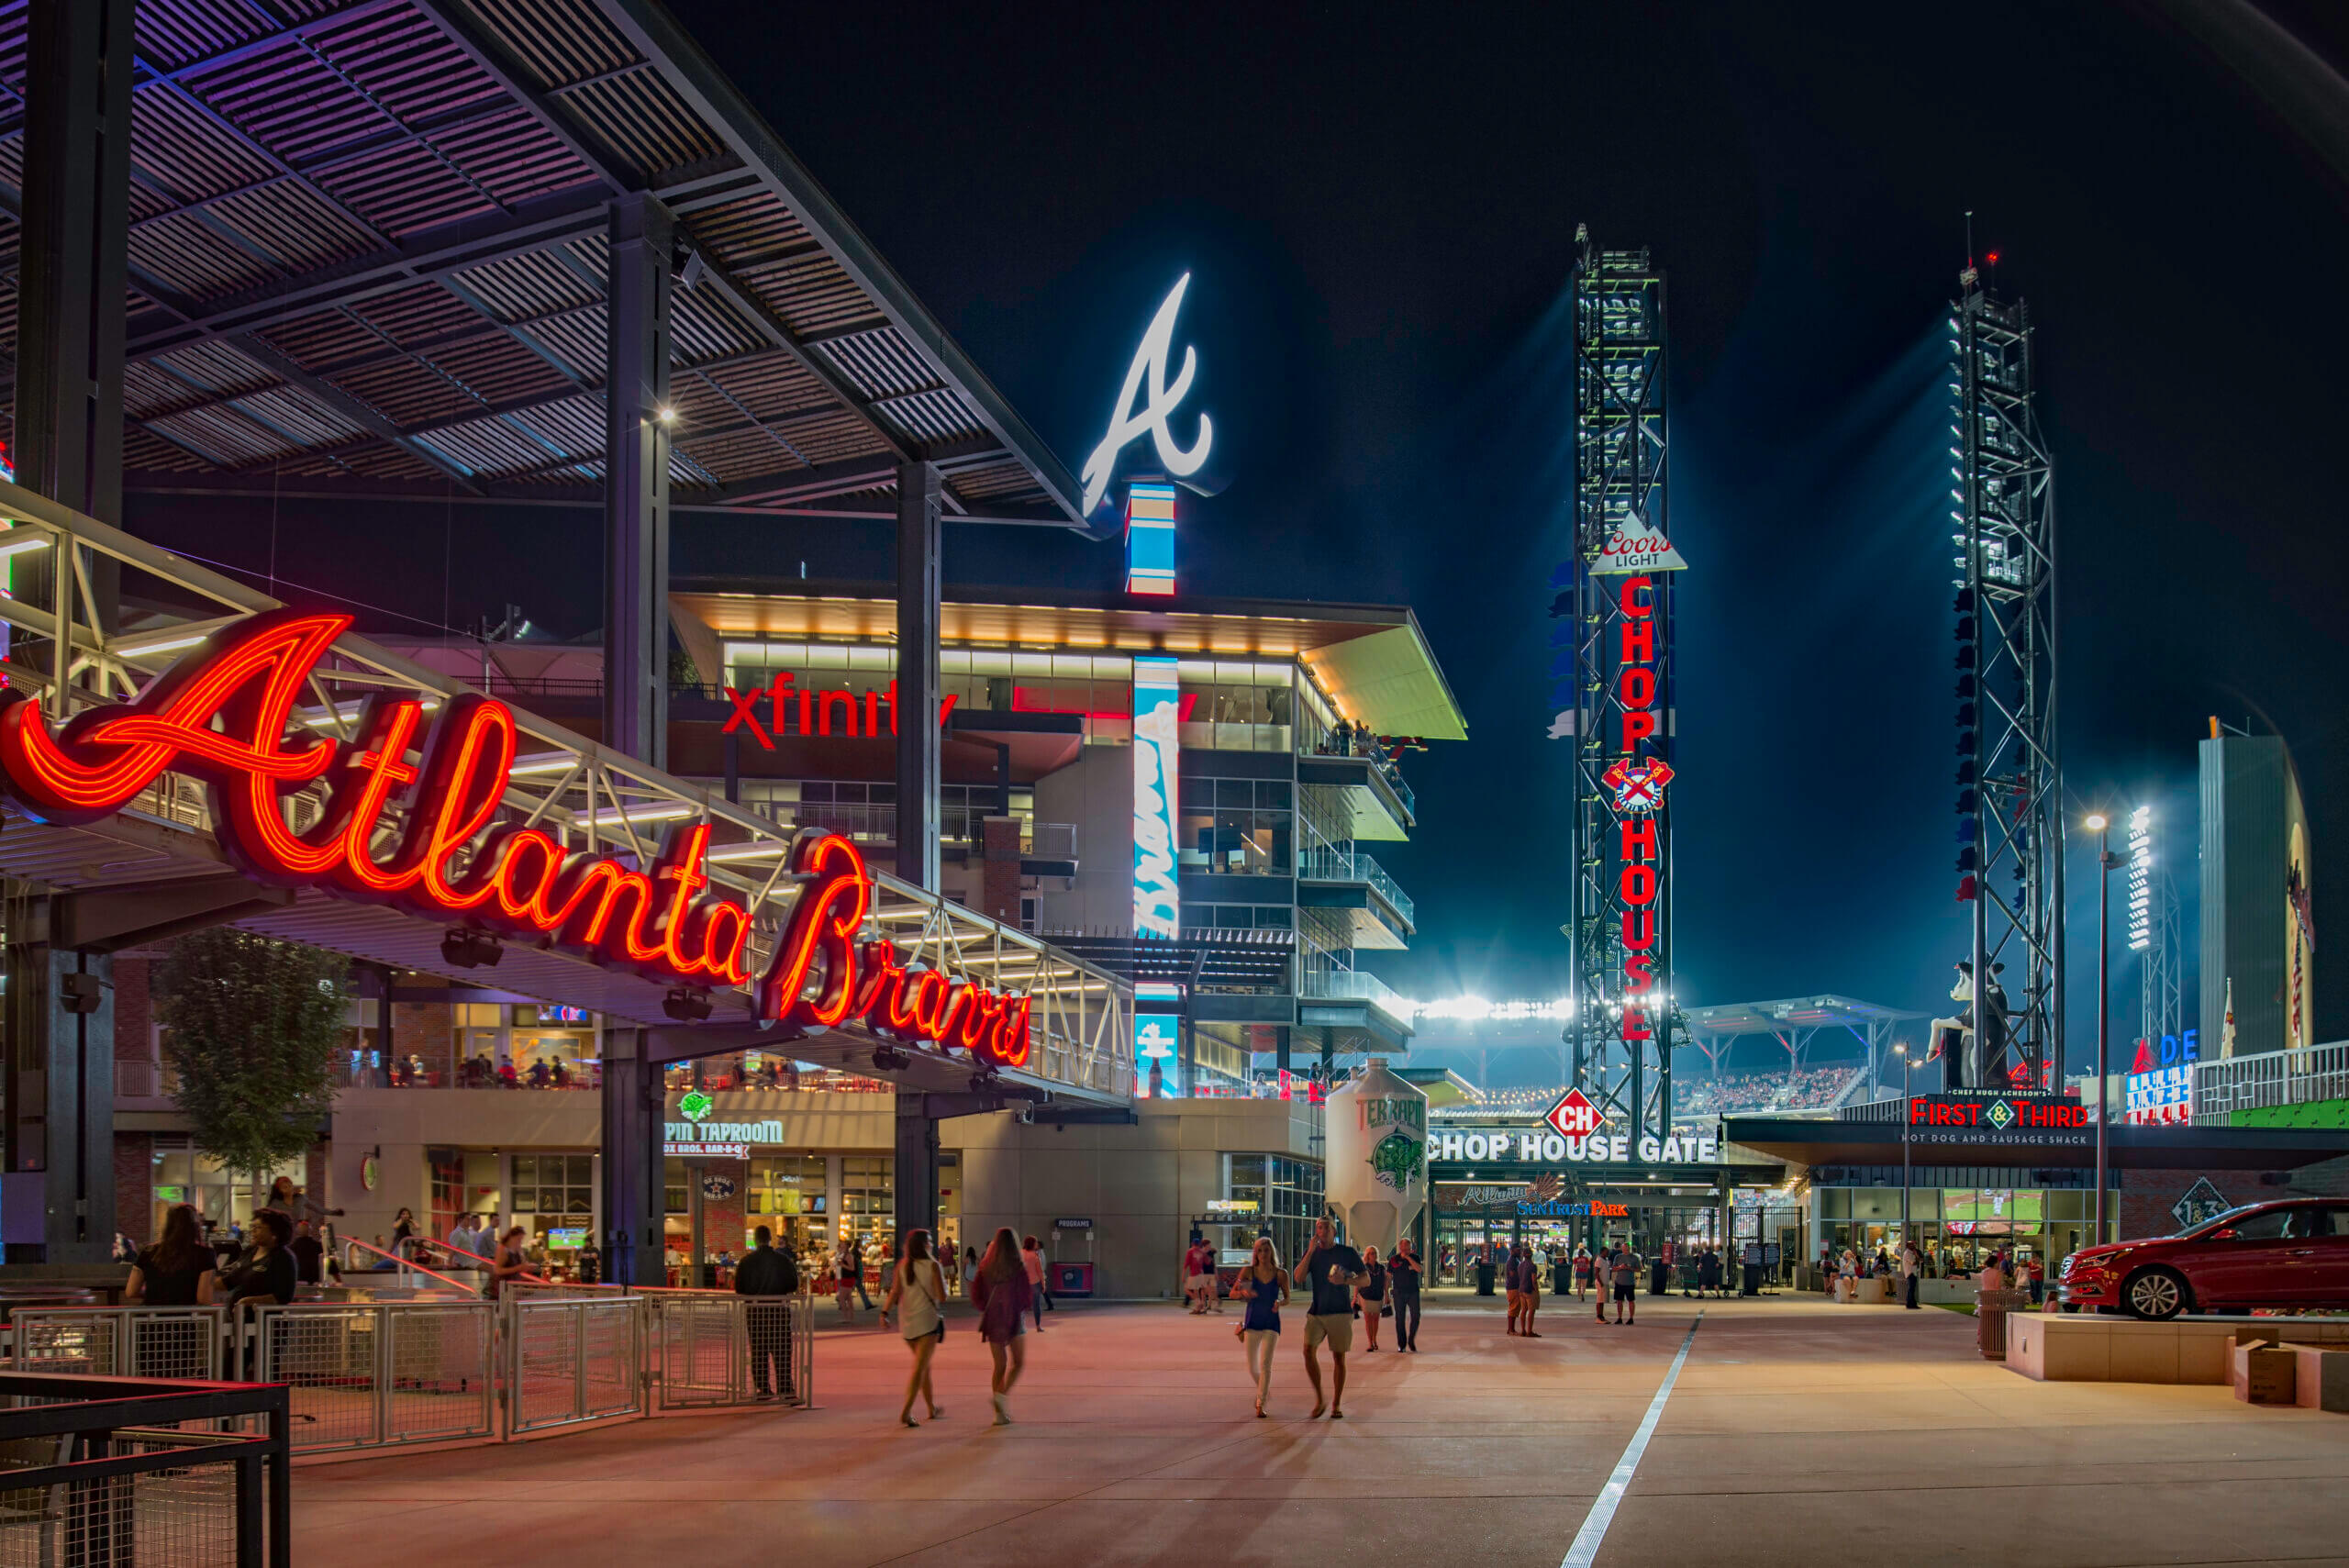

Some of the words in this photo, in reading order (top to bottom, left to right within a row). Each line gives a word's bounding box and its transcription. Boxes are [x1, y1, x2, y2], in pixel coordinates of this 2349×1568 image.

[1602, 530, 1674, 556] Coors
[1616, 553, 1660, 567] LIGHT
[1620, 576, 1654, 753] CHOP
[4, 614, 753, 986] Atlanta
[773, 833, 1032, 1068] Braves
[1620, 819, 1655, 1040] HOUSE
[2160, 1029, 2197, 1065] DE
[1558, 1105, 1593, 1131] CH
[1910, 1098, 1982, 1125] FIRST
[1994, 1106, 2007, 1121] &
[2012, 1100, 2088, 1128] THIRD
[664, 1122, 695, 1141] PIN
[697, 1120, 784, 1143] TAPROOM
[1932, 1134, 1956, 1143] DOG
[1963, 1135, 1986, 1143] AND
[1991, 1135, 2044, 1144] SAUSAGE
[2049, 1136, 2087, 1144] SHACK
[663, 1144, 676, 1153] OX
[706, 1144, 740, 1153] BAR-B-Q
[1428, 1135, 1509, 1161] CHOP
[1520, 1135, 1629, 1162] HOUSE
[1638, 1137, 1716, 1162] GATE
[1058, 1219, 1090, 1228] PROGRAMS
